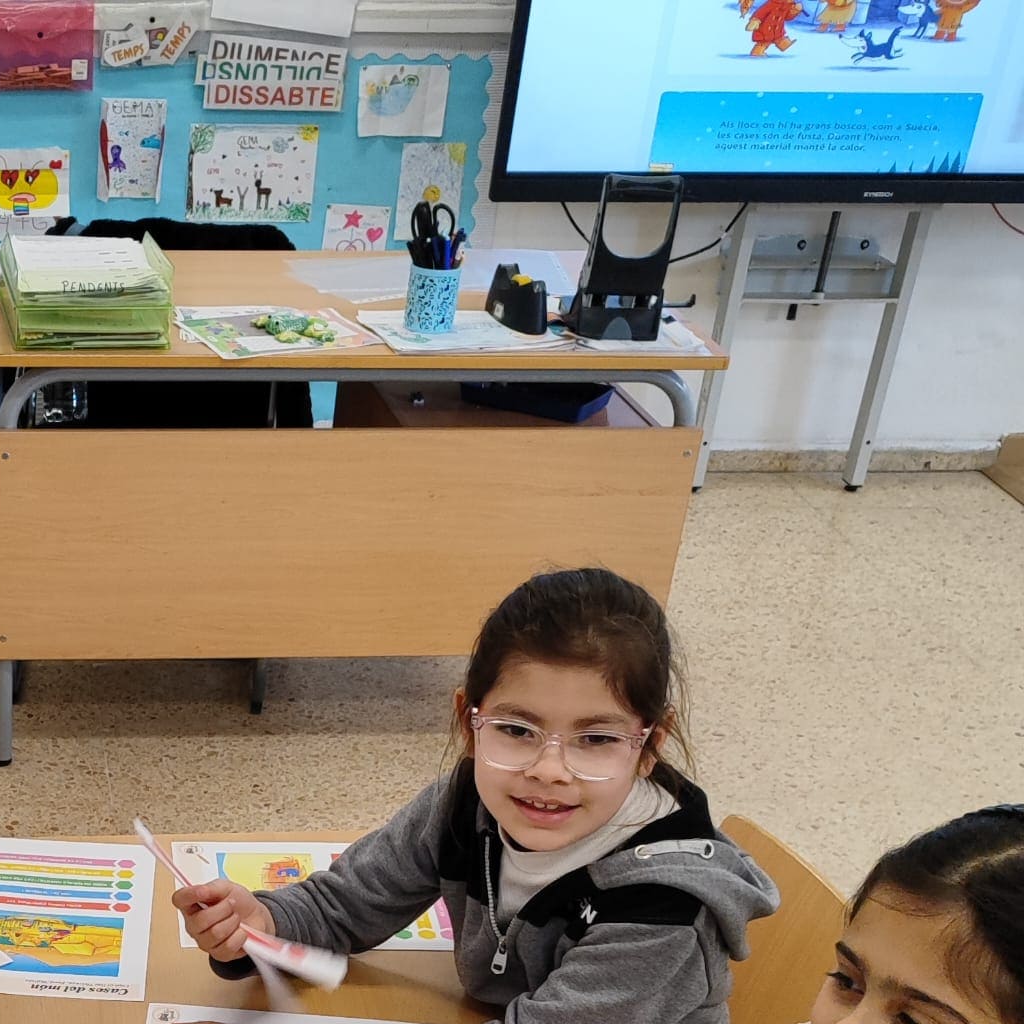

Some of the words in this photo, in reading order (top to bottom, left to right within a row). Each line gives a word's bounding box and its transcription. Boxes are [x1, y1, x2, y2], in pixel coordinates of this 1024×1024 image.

[159, 21, 192, 60] TEMPS
[111, 42, 146, 63] TEMPS
[215, 84, 336, 107] DISSABTE
[719, 121, 735, 129] Als
[805, 123, 831, 132] grans
[717, 131, 732, 139] les
[734, 131, 759, 139] cases
[782, 131, 794, 139] de
[827, 132, 860, 140] Durant
[714, 143, 747, 152] aquest
[750, 143, 791, 151] material
[793, 143, 826, 151] manté
[61, 279, 126, 293] PENDENTS
[29, 983, 61, 992] món
[63, 985, 86, 993] del
[87, 986, 128, 995] Cases
